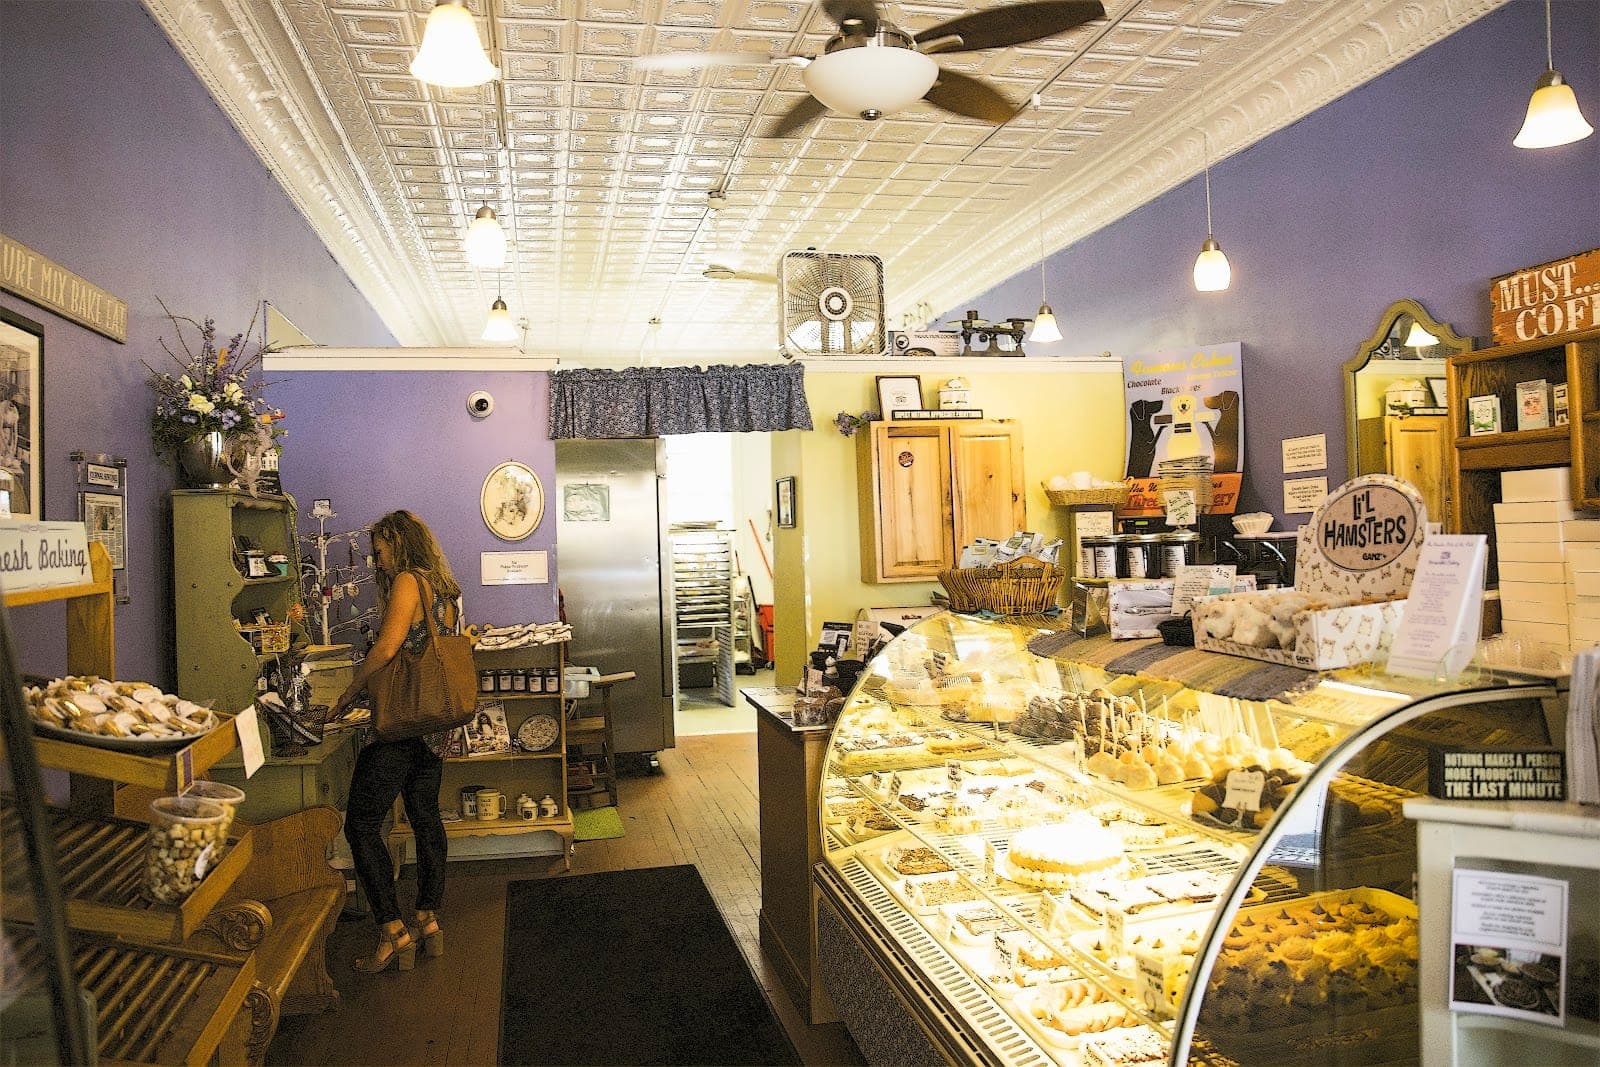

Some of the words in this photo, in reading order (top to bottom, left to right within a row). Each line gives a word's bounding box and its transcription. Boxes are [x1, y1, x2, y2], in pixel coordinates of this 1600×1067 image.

[2, 244, 35, 291] URE
[41, 264, 67, 307] MIX
[71, 280, 102, 324] BAKE
[106, 300, 126, 334] EAT
[1127, 378, 1162, 389] Chocolate
[1324, 515, 1406, 550] HAMSTERS
[0, 539, 32, 571] esh
[38, 539, 87, 576] Baking
[1444, 753, 1483, 767] NOTHING
[1485, 753, 1514, 767] MAKES
[1516, 754, 1523, 767] A
[1444, 768, 1473, 781] MORE
[1473, 768, 1534, 781] PRODUCTIVE
[1535, 768, 1561, 781] THAN
[1444, 782, 1471, 797] THE
[1472, 782, 1506, 797] LAST
[1508, 782, 1561, 797] MINUTE
